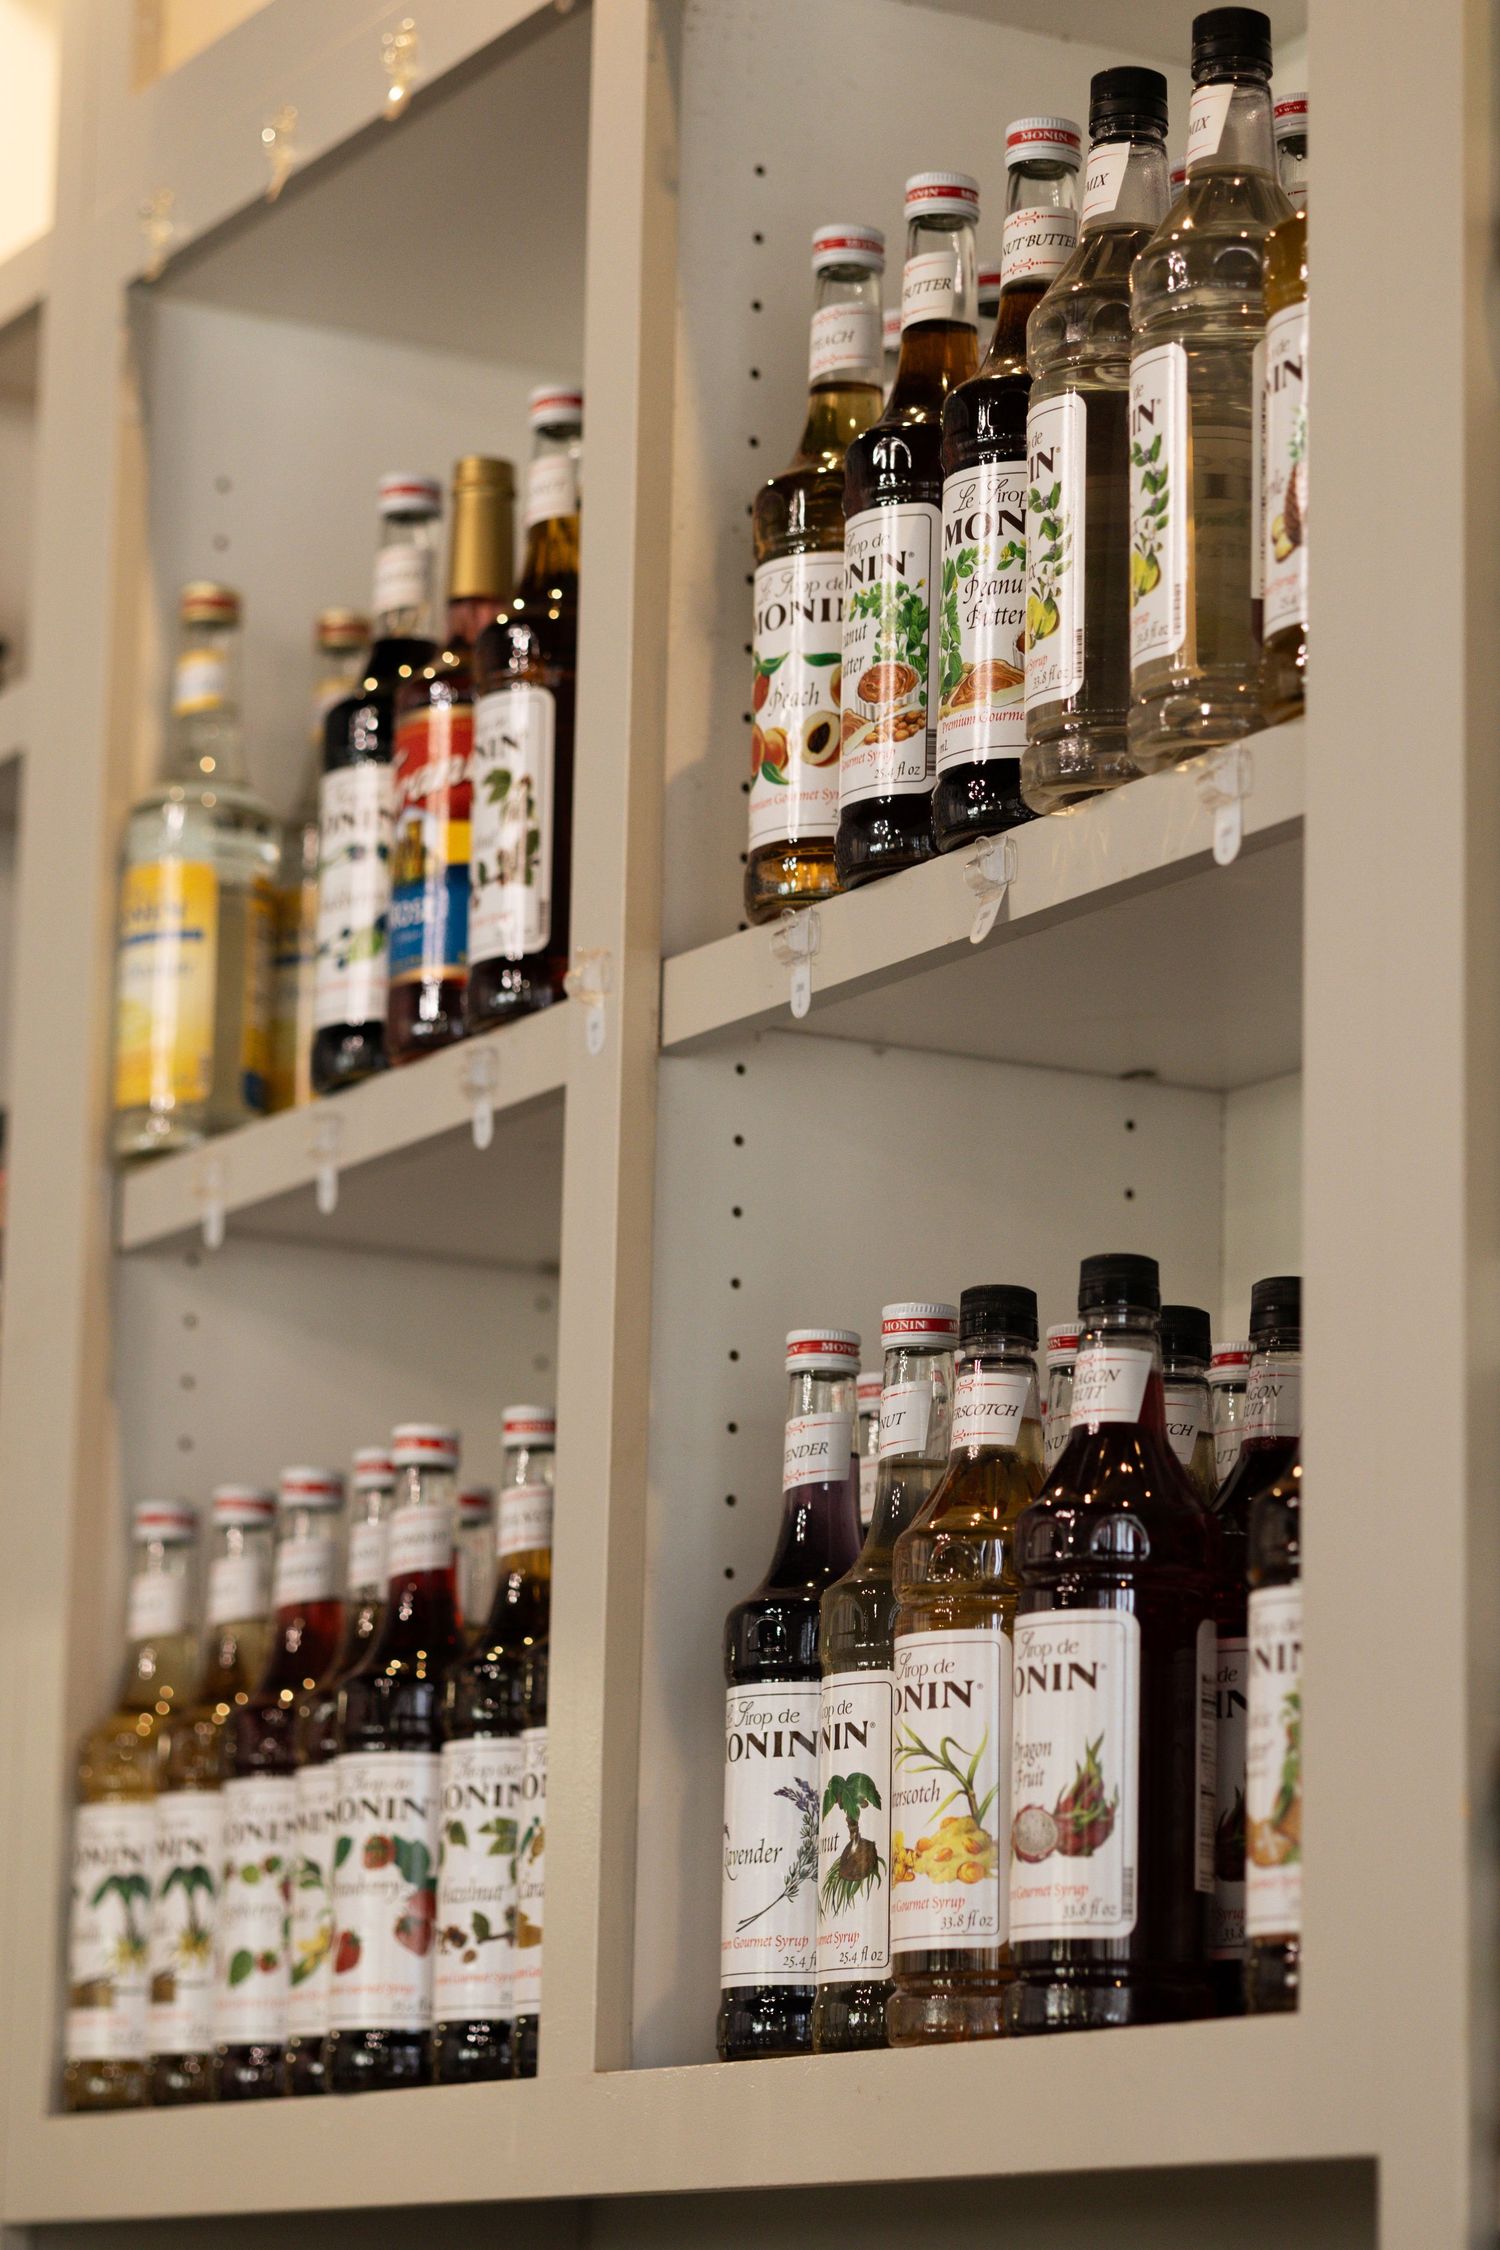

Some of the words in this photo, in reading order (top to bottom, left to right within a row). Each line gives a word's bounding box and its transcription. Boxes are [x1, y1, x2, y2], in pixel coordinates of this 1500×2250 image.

[1020, 131, 1068, 142] MONIN
[1001, 236, 1025, 257] NUT
[1266, 355, 1304, 393] IN
[1132, 399, 1156, 437] IN
[1029, 447, 1056, 484] IN
[945, 509, 1026, 551] MON
[844, 551, 906, 590] NIN
[775, 571, 820, 598] Siop
[963, 571, 1026, 605] Peanu
[758, 598, 843, 636] ONI
[844, 623, 868, 649] nut
[767, 681, 820, 717] Peach
[979, 710, 1024, 724] Gourme
[907, 766, 920, 776] oz
[774, 789, 819, 805] Gomet
[822, 786, 840, 806] Syr
[884, 1320, 927, 1332] MONIN
[821, 1340, 858, 1355] MON
[1074, 1385, 1107, 1401] UIT
[1247, 1384, 1284, 1401] GON
[880, 1411, 907, 1430] NUT
[952, 1402, 1019, 1418] ERSCOTCH
[1243, 1400, 1269, 1418] UIT
[1165, 1422, 1195, 1437] TCH
[785, 1441, 829, 1464] ENDER
[1216, 1449, 1239, 1465] UT
[934, 1658, 956, 1675] de
[1014, 1661, 1098, 1698] ONIN
[893, 1680, 975, 1716] ONIN
[1216, 1690, 1248, 1720] IN
[735, 1700, 773, 1731] Sirop
[778, 1708, 800, 1724] de
[822, 1705, 835, 1725] op
[836, 1699, 853, 1716] de
[727, 1730, 819, 1763] ONIN
[821, 1720, 869, 1753] NIN
[440, 1781, 521, 1813] ONI
[891, 1778, 941, 1809] erscotch
[335, 1796, 428, 1823] ONIN
[821, 1831, 840, 1855] nut
[933, 1895, 966, 1914] Syrup
[940, 1914, 964, 1930] 33.8
[962, 1909, 980, 1934] fl
[979, 1916, 993, 1927] oz
[733, 1936, 773, 1950] Gourmet
[775, 1934, 809, 1953] Syrup
[817, 1932, 833, 1946] met
[834, 1930, 861, 1950] Syrup
[783, 1956, 807, 1969] 25.4
[839, 1950, 858, 1965] 25.4
[858, 1946, 869, 1966] fl
[871, 1950, 883, 1962] oz
